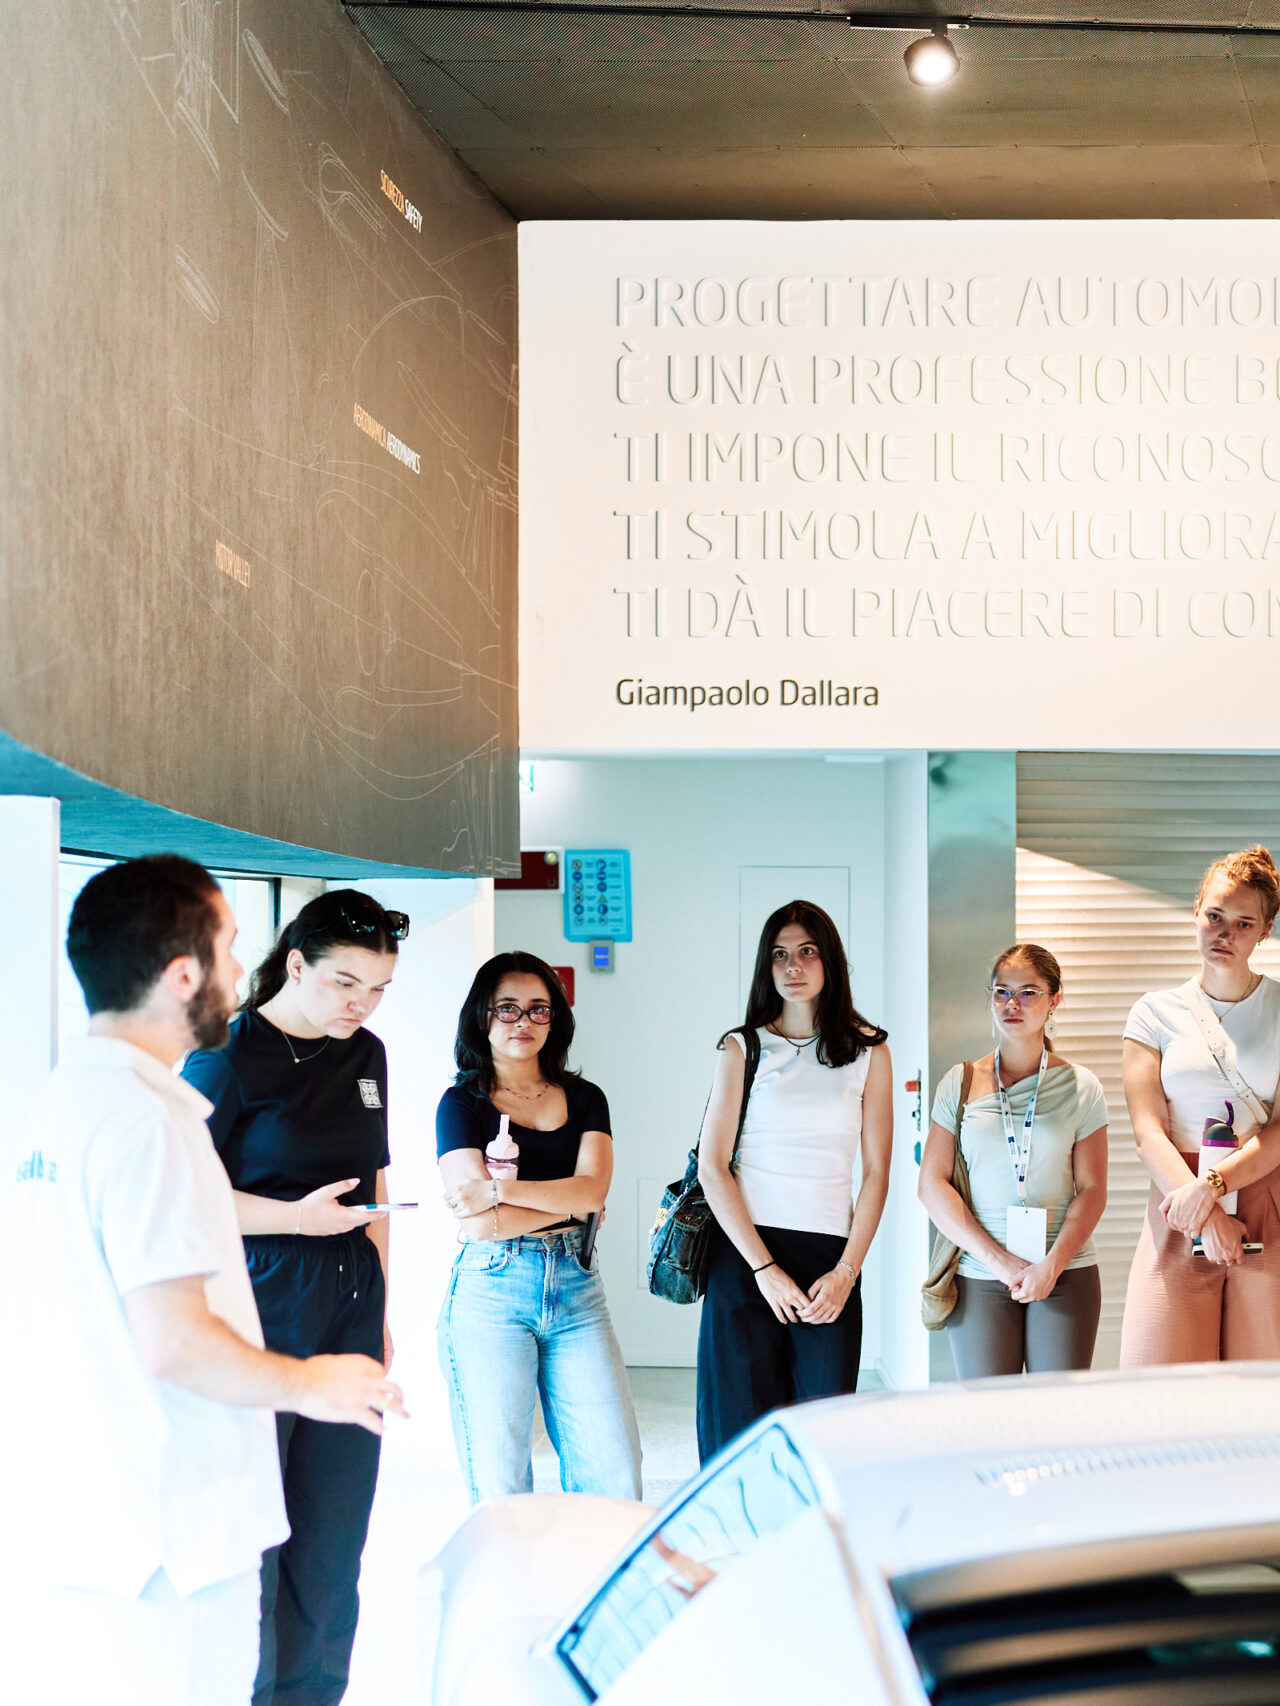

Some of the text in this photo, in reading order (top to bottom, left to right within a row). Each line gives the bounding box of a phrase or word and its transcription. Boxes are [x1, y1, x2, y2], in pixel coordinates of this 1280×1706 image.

[404, 198, 423, 234] SAFETY
[615, 275, 998, 328] PROGETTARE
[614, 341, 652, 405] È
[666, 353, 795, 405] UNA
[811, 353, 1216, 405] PROFESSIONE
[612, 431, 668, 483] TI
[686, 431, 912, 483] IMPONE
[932, 431, 986, 483] IL
[612, 509, 668, 561] TI
[686, 509, 945, 561] STIMOLA
[960, 509, 1001, 561] A
[612, 587, 669, 640] TI
[687, 573, 768, 640] DÀ
[784, 587, 836, 640] IL
[851, 587, 1090, 640] PIACERE
[1112, 587, 1167, 640] DI
[615, 677, 880, 713] Giampaolo Dallara
